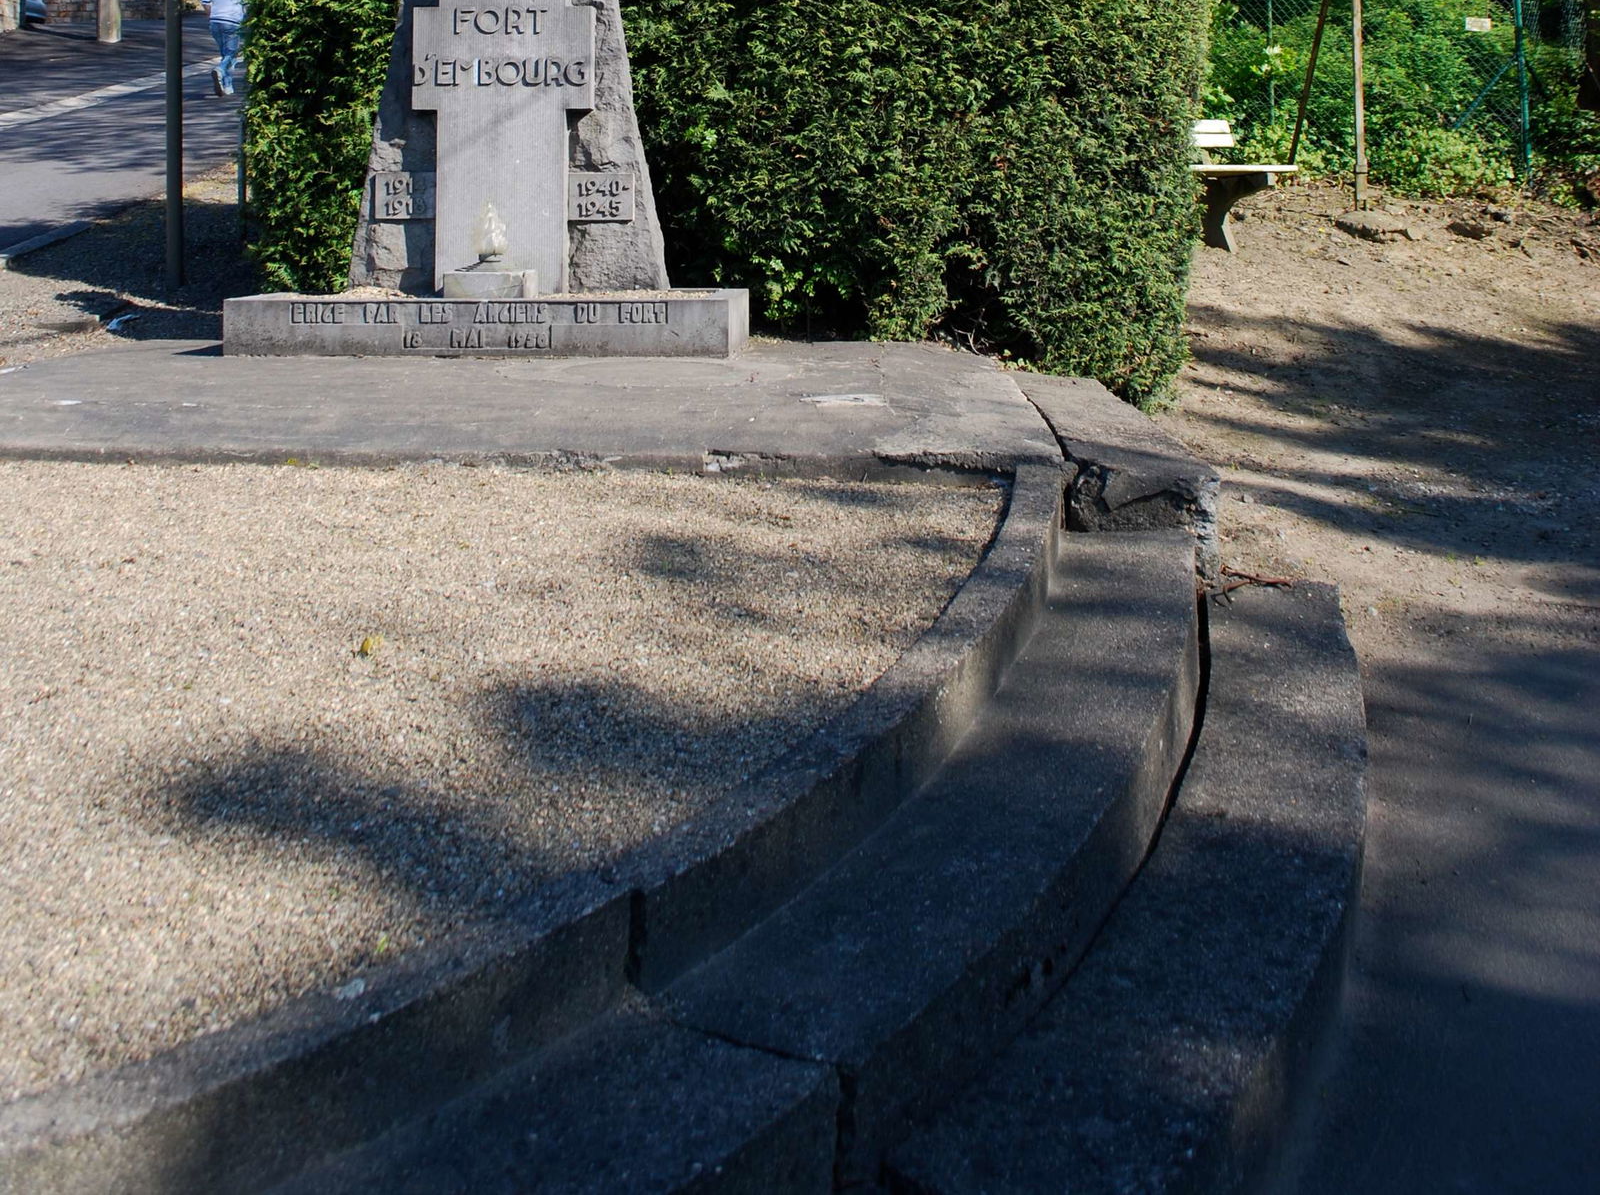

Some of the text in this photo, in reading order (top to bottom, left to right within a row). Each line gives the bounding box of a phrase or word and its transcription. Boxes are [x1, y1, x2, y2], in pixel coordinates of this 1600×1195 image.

[453, 7, 548, 35] FORT
[412, 53, 589, 88] D'EMBOURG
[385, 197, 426, 216] 1918
[577, 199, 622, 218] 1945
[363, 303, 399, 324] PAR
[418, 303, 453, 324] LES
[473, 303, 548, 324] ANCIENS
[575, 303, 600, 324] DU
[618, 303, 667, 324] FORT
[403, 328, 549, 349] 18 MAI 1950
